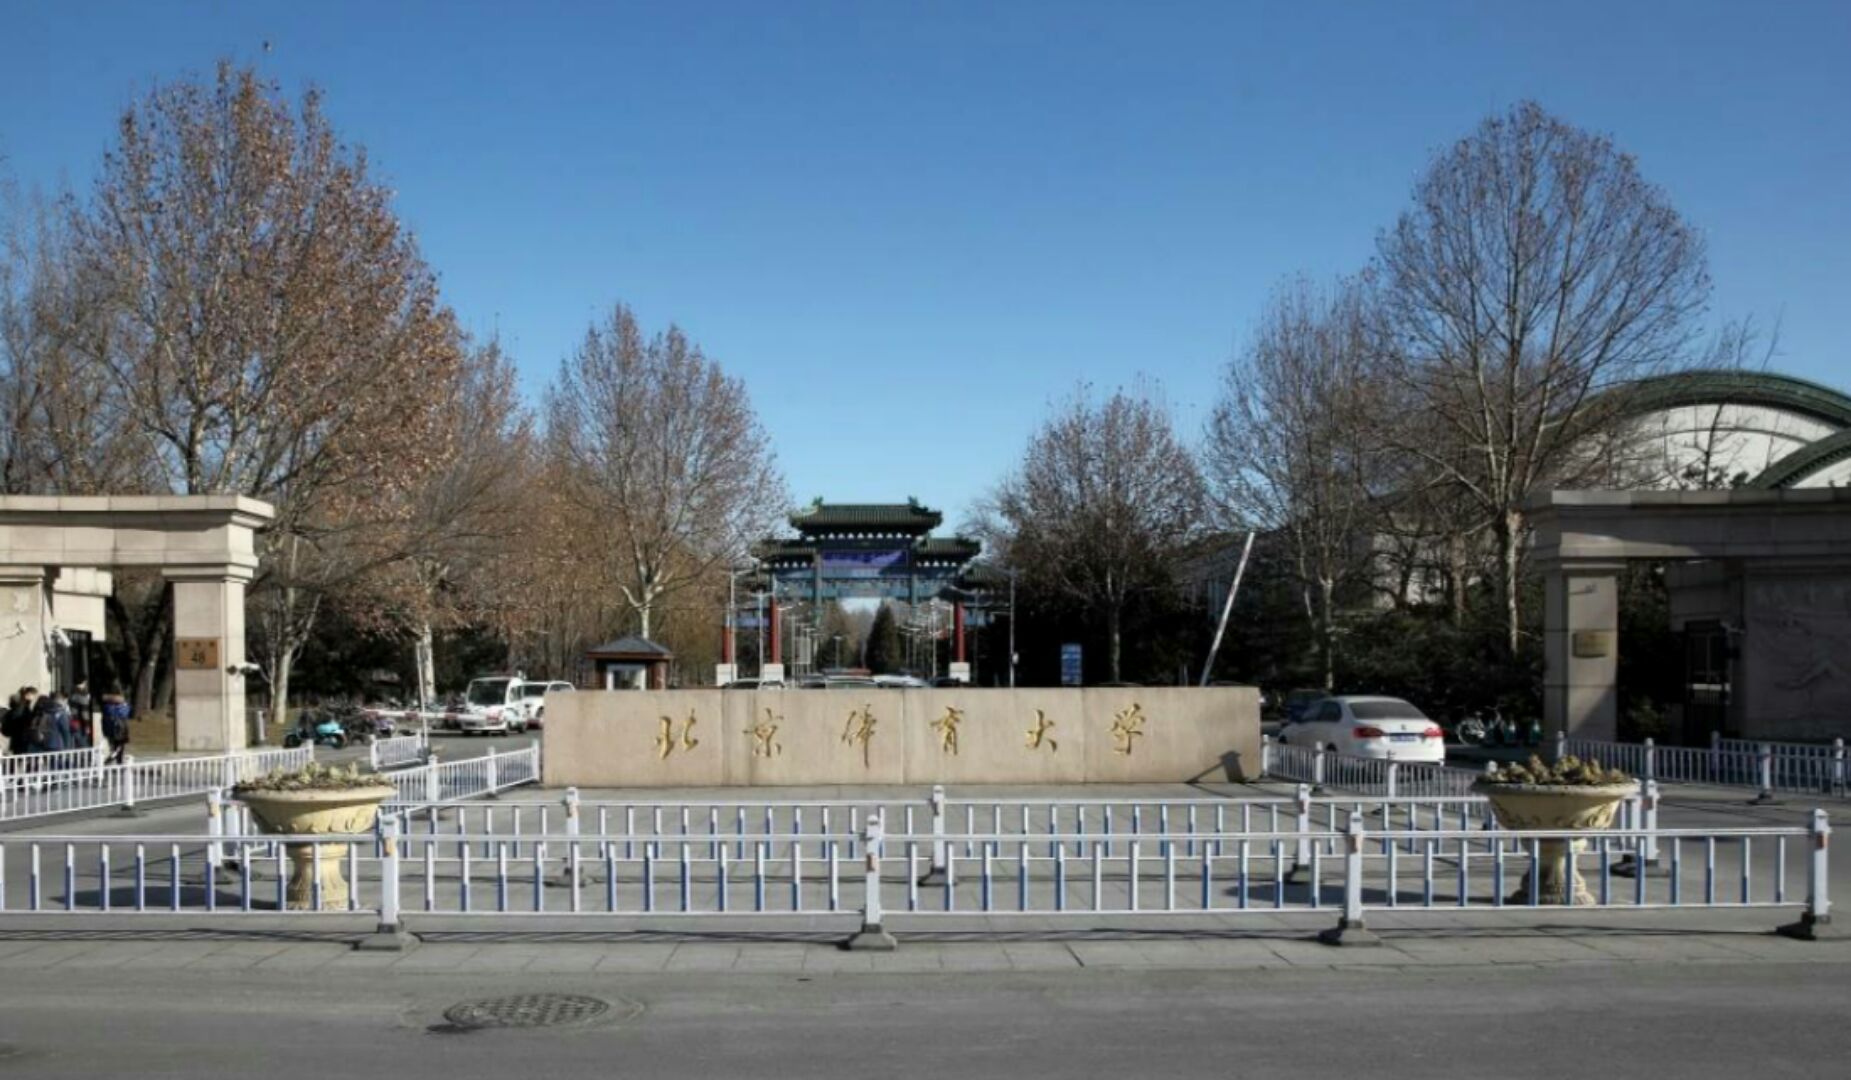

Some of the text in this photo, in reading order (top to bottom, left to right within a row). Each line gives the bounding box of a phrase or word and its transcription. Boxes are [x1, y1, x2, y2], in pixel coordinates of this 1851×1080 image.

[656, 703, 1146, 769] 北京体育大学
